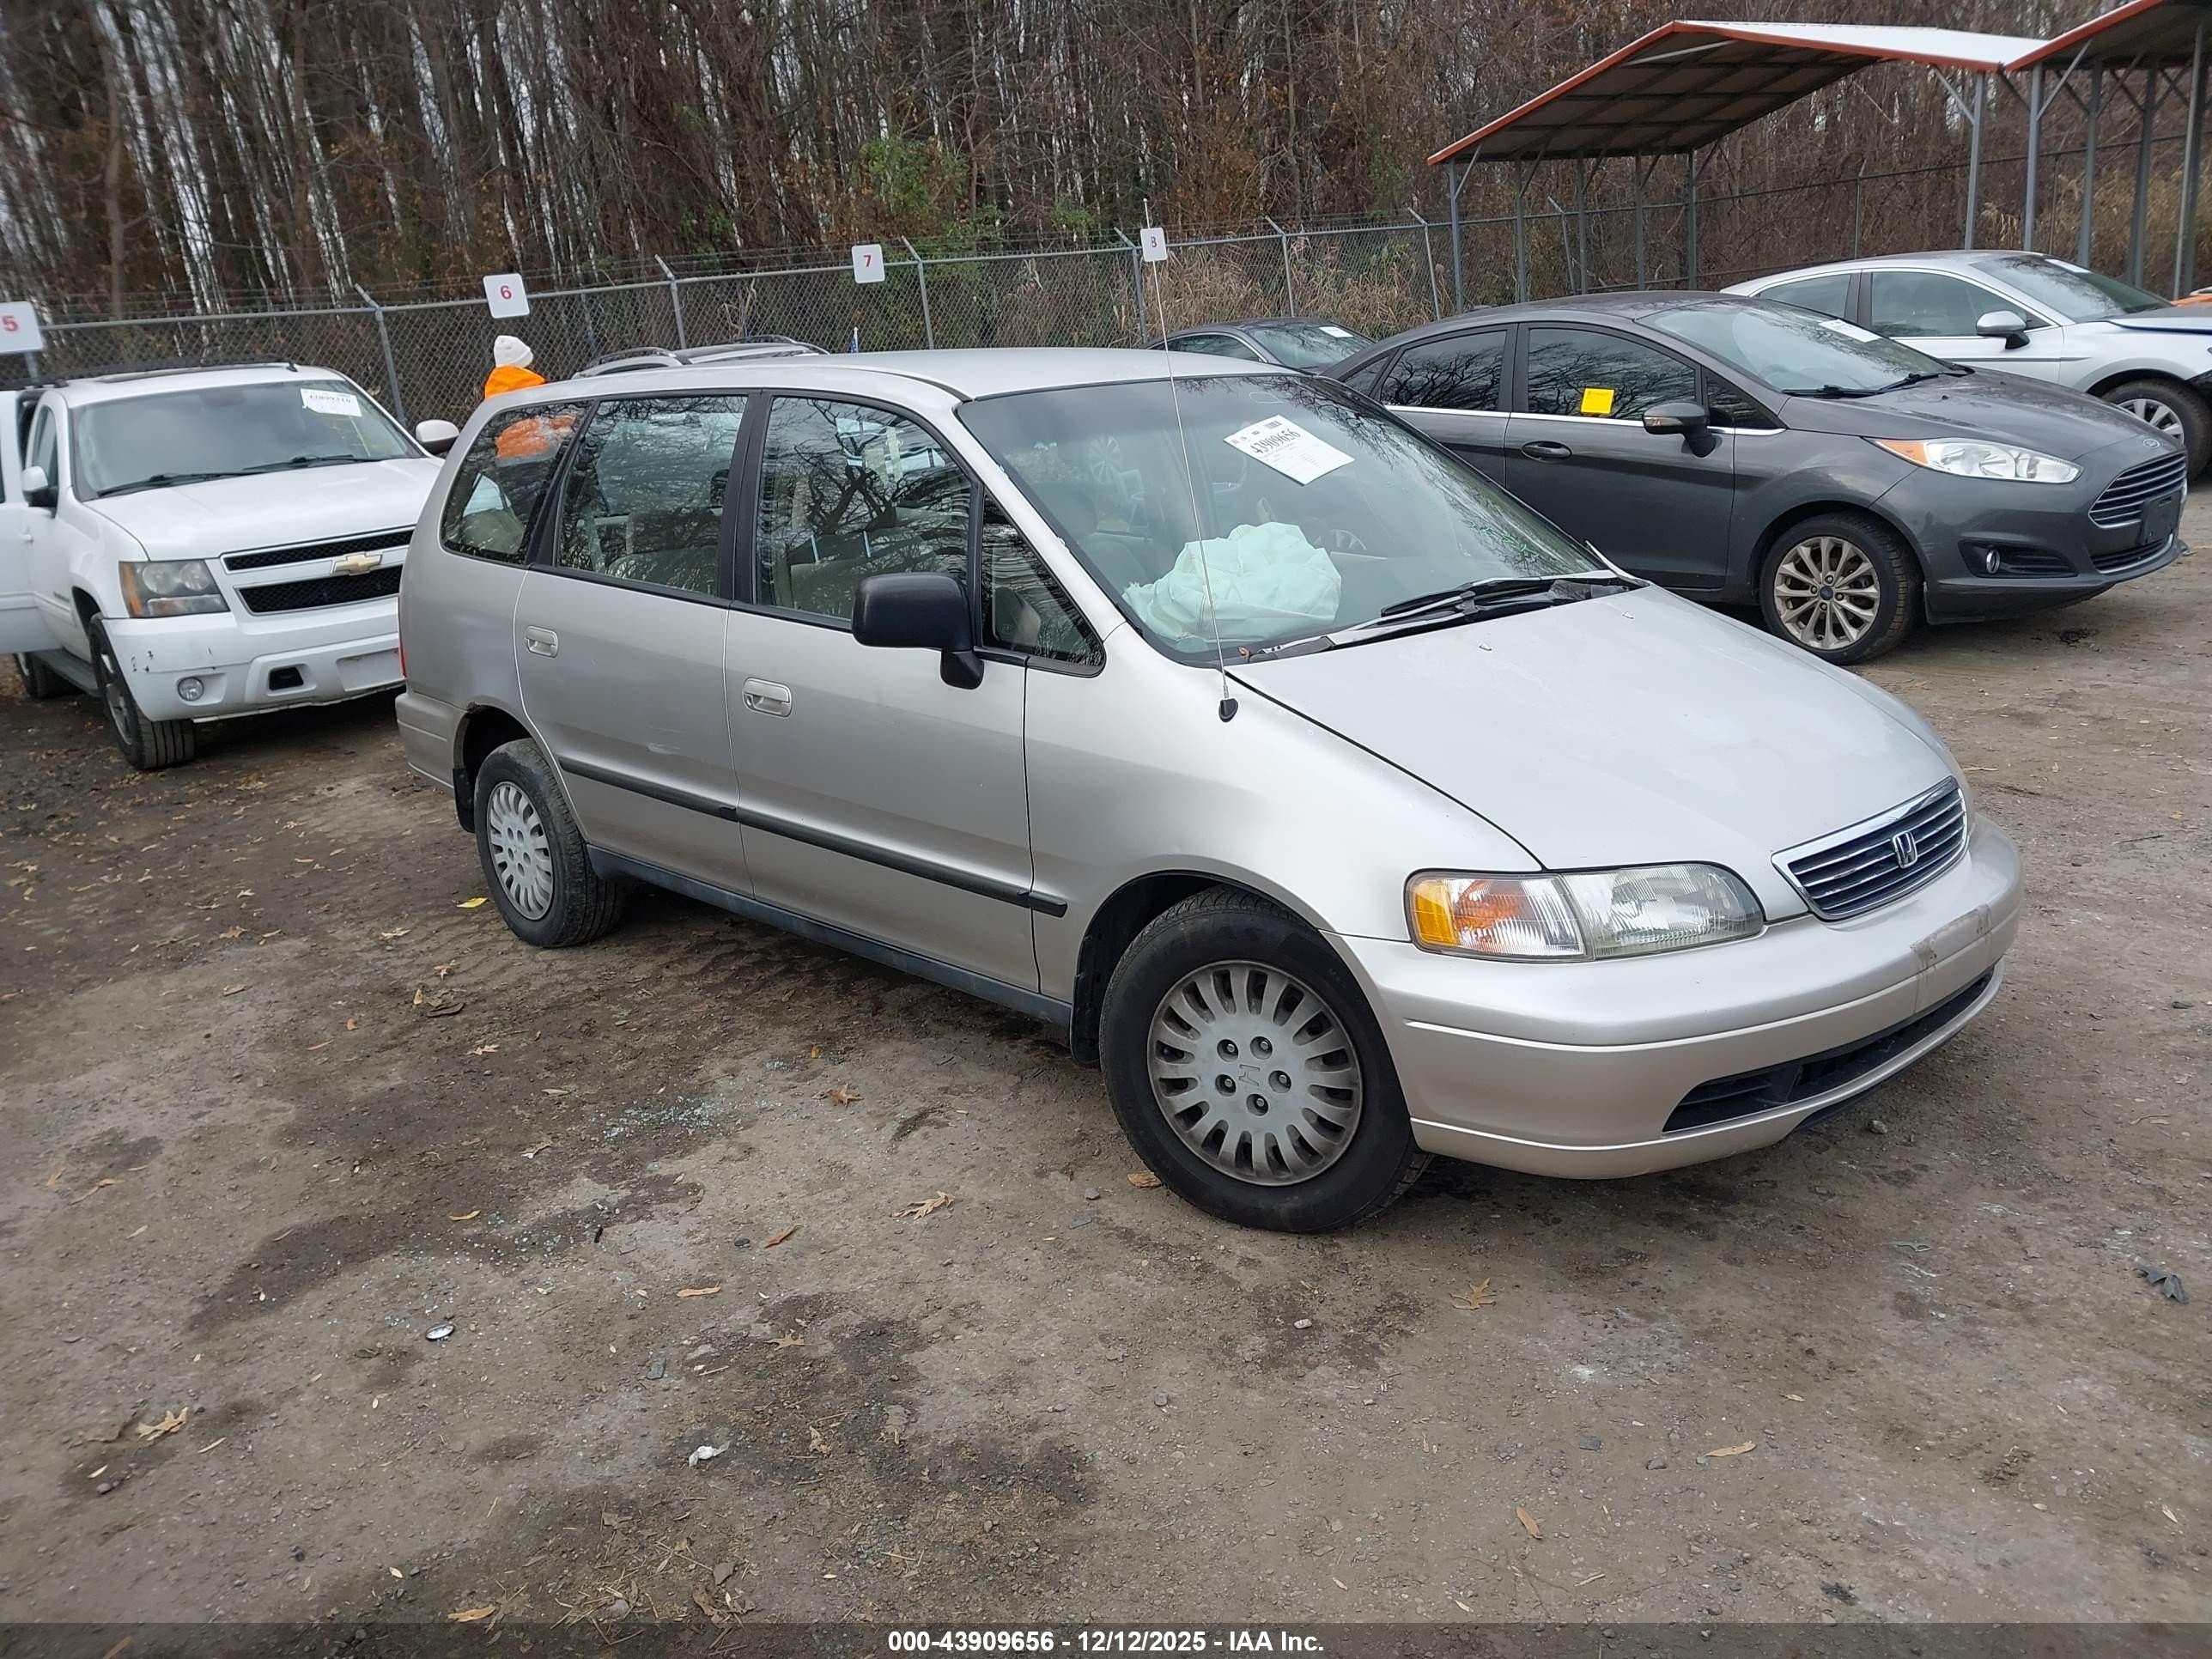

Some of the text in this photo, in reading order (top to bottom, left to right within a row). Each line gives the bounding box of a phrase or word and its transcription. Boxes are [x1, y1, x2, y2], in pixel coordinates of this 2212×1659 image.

[863, 255, 872, 268] 7
[500, 285, 513, 300] 6
[2, 316, 19, 331] 5
[1249, 428, 1301, 455] 43909656
